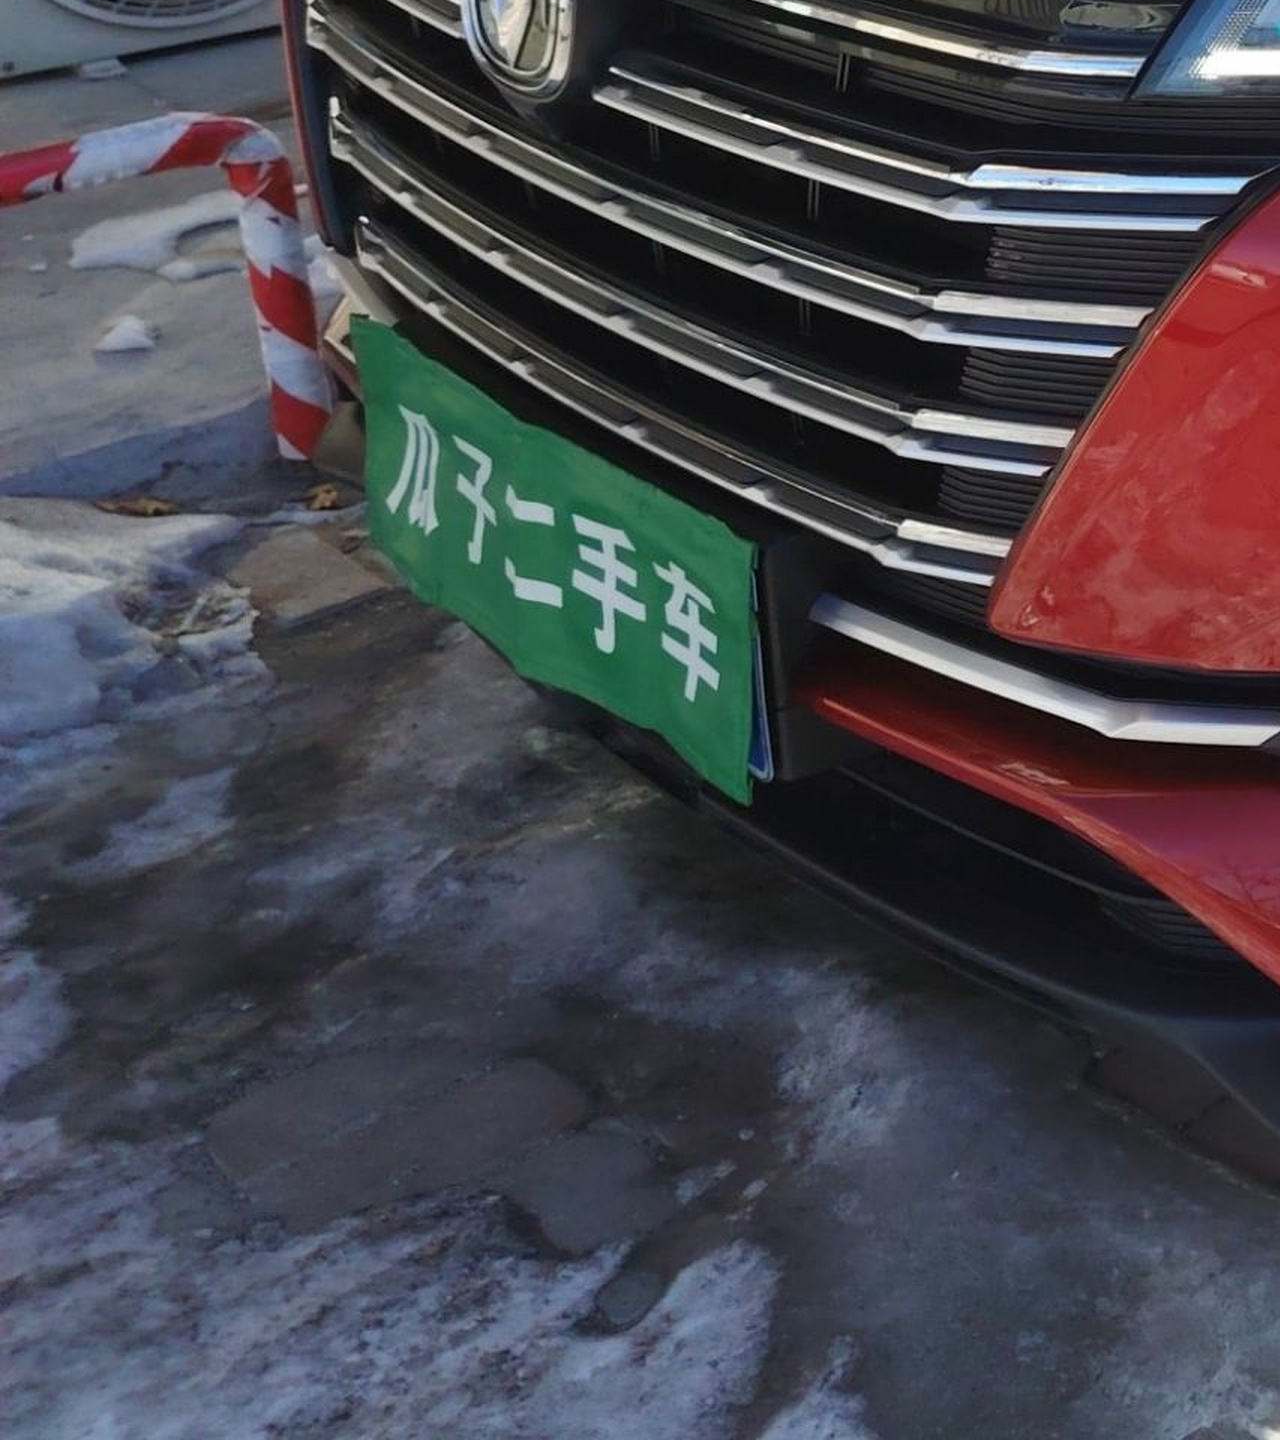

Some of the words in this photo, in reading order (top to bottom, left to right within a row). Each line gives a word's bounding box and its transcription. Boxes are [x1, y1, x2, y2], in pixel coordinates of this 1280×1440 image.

[385, 403, 721, 703] 瓜子二手车
